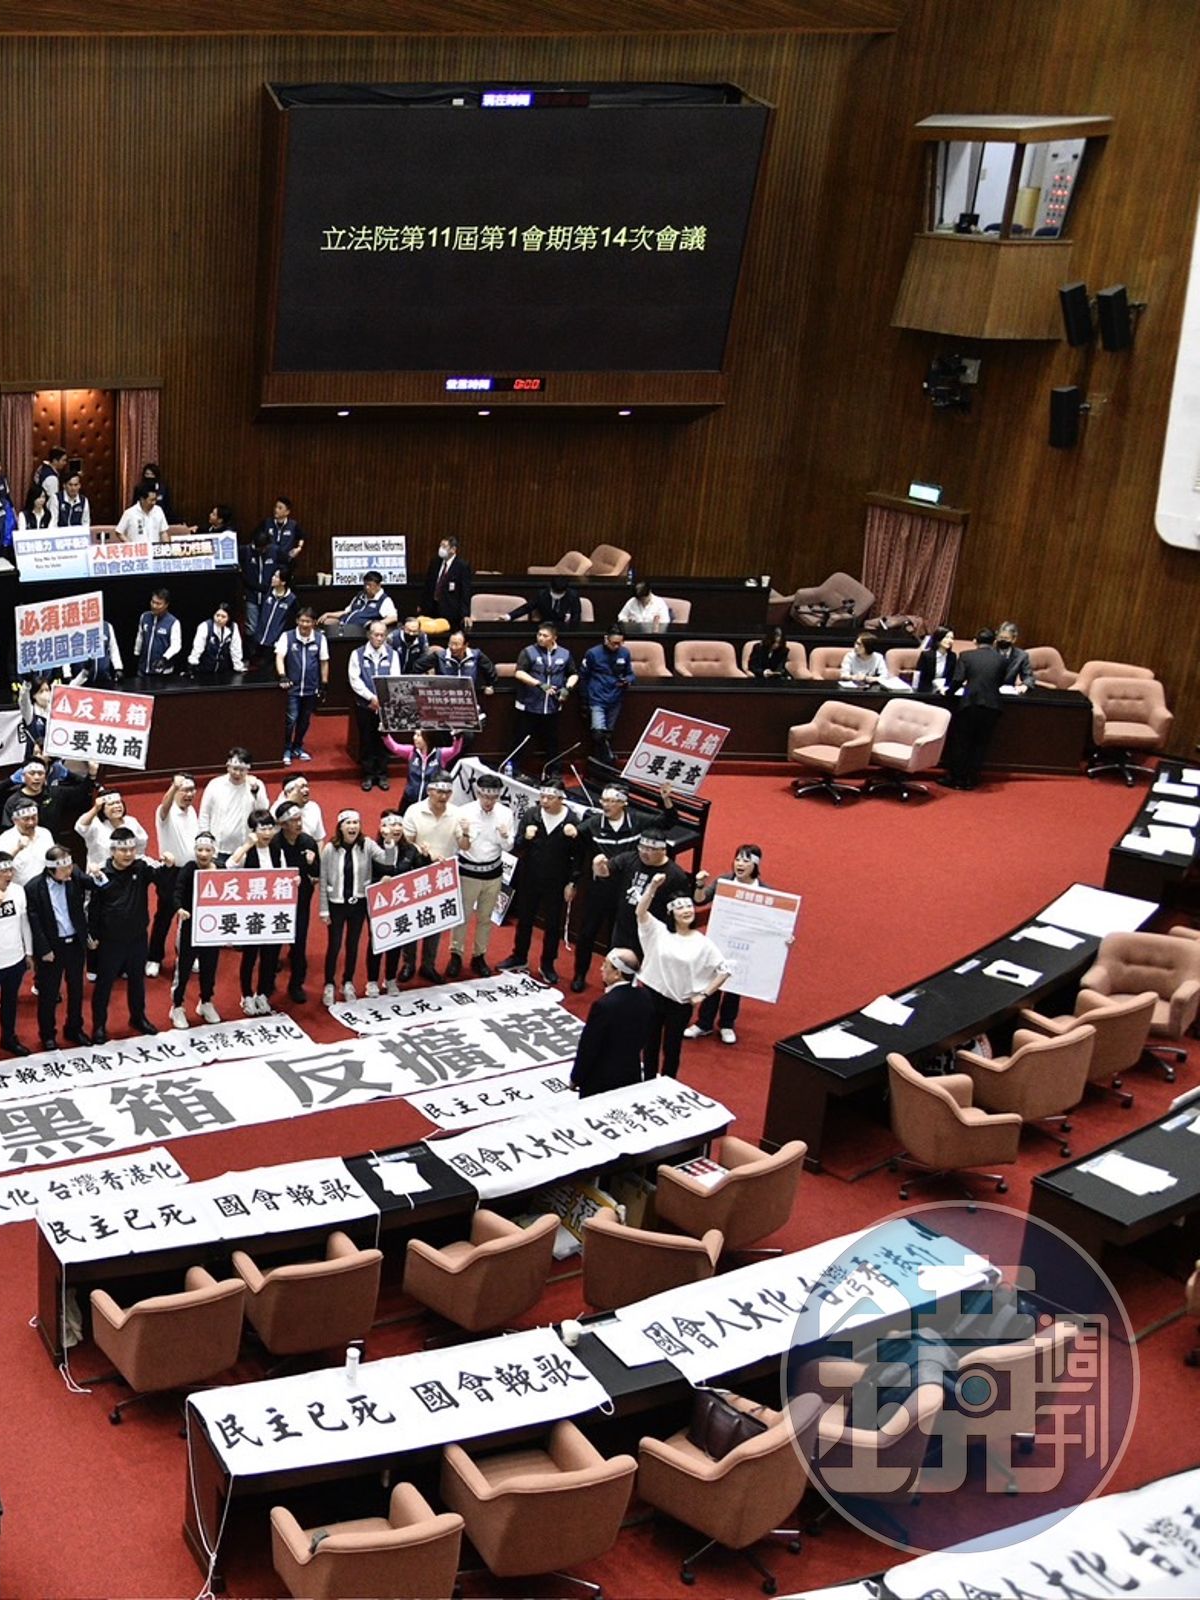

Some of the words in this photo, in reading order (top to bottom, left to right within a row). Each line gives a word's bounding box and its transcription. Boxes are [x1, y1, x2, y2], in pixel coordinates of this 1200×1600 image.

[320, 225, 708, 253] 立法院第11屆第1會期第14次會議
[93, 543, 149, 560] 人民有權
[93, 559, 149, 575] 國會改革
[20, 597, 101, 636] 必須通過
[20, 628, 101, 667] 藐視國會罪
[73, 697, 148, 727] 反黑箱
[69, 730, 143, 760] 要協商
[662, 724, 721, 756] 反黑箱
[646, 755, 702, 785] 要審查
[218, 875, 295, 901] 反黑箱
[388, 866, 455, 907] 反黑箱
[218, 911, 293, 935] 要審查
[392, 896, 458, 936] 要協商
[340, 998, 443, 1027] 民主已死
[266, 1004, 586, 1109] 反擴權
[423, 1086, 534, 1120] 民主已死
[448, 1126, 593, 1179] 國會人大化
[585, 1089, 718, 1143] 台灣香港化
[48, 1159, 183, 1201] 台灣香港化
[47, 1202, 197, 1247] 民主已死
[213, 1178, 364, 1219] 國會輓歌
[642, 1287, 810, 1357] 國會人大化
[215, 1392, 398, 1450] 民主已死
[410, 1353, 591, 1414] 國會輓歌
